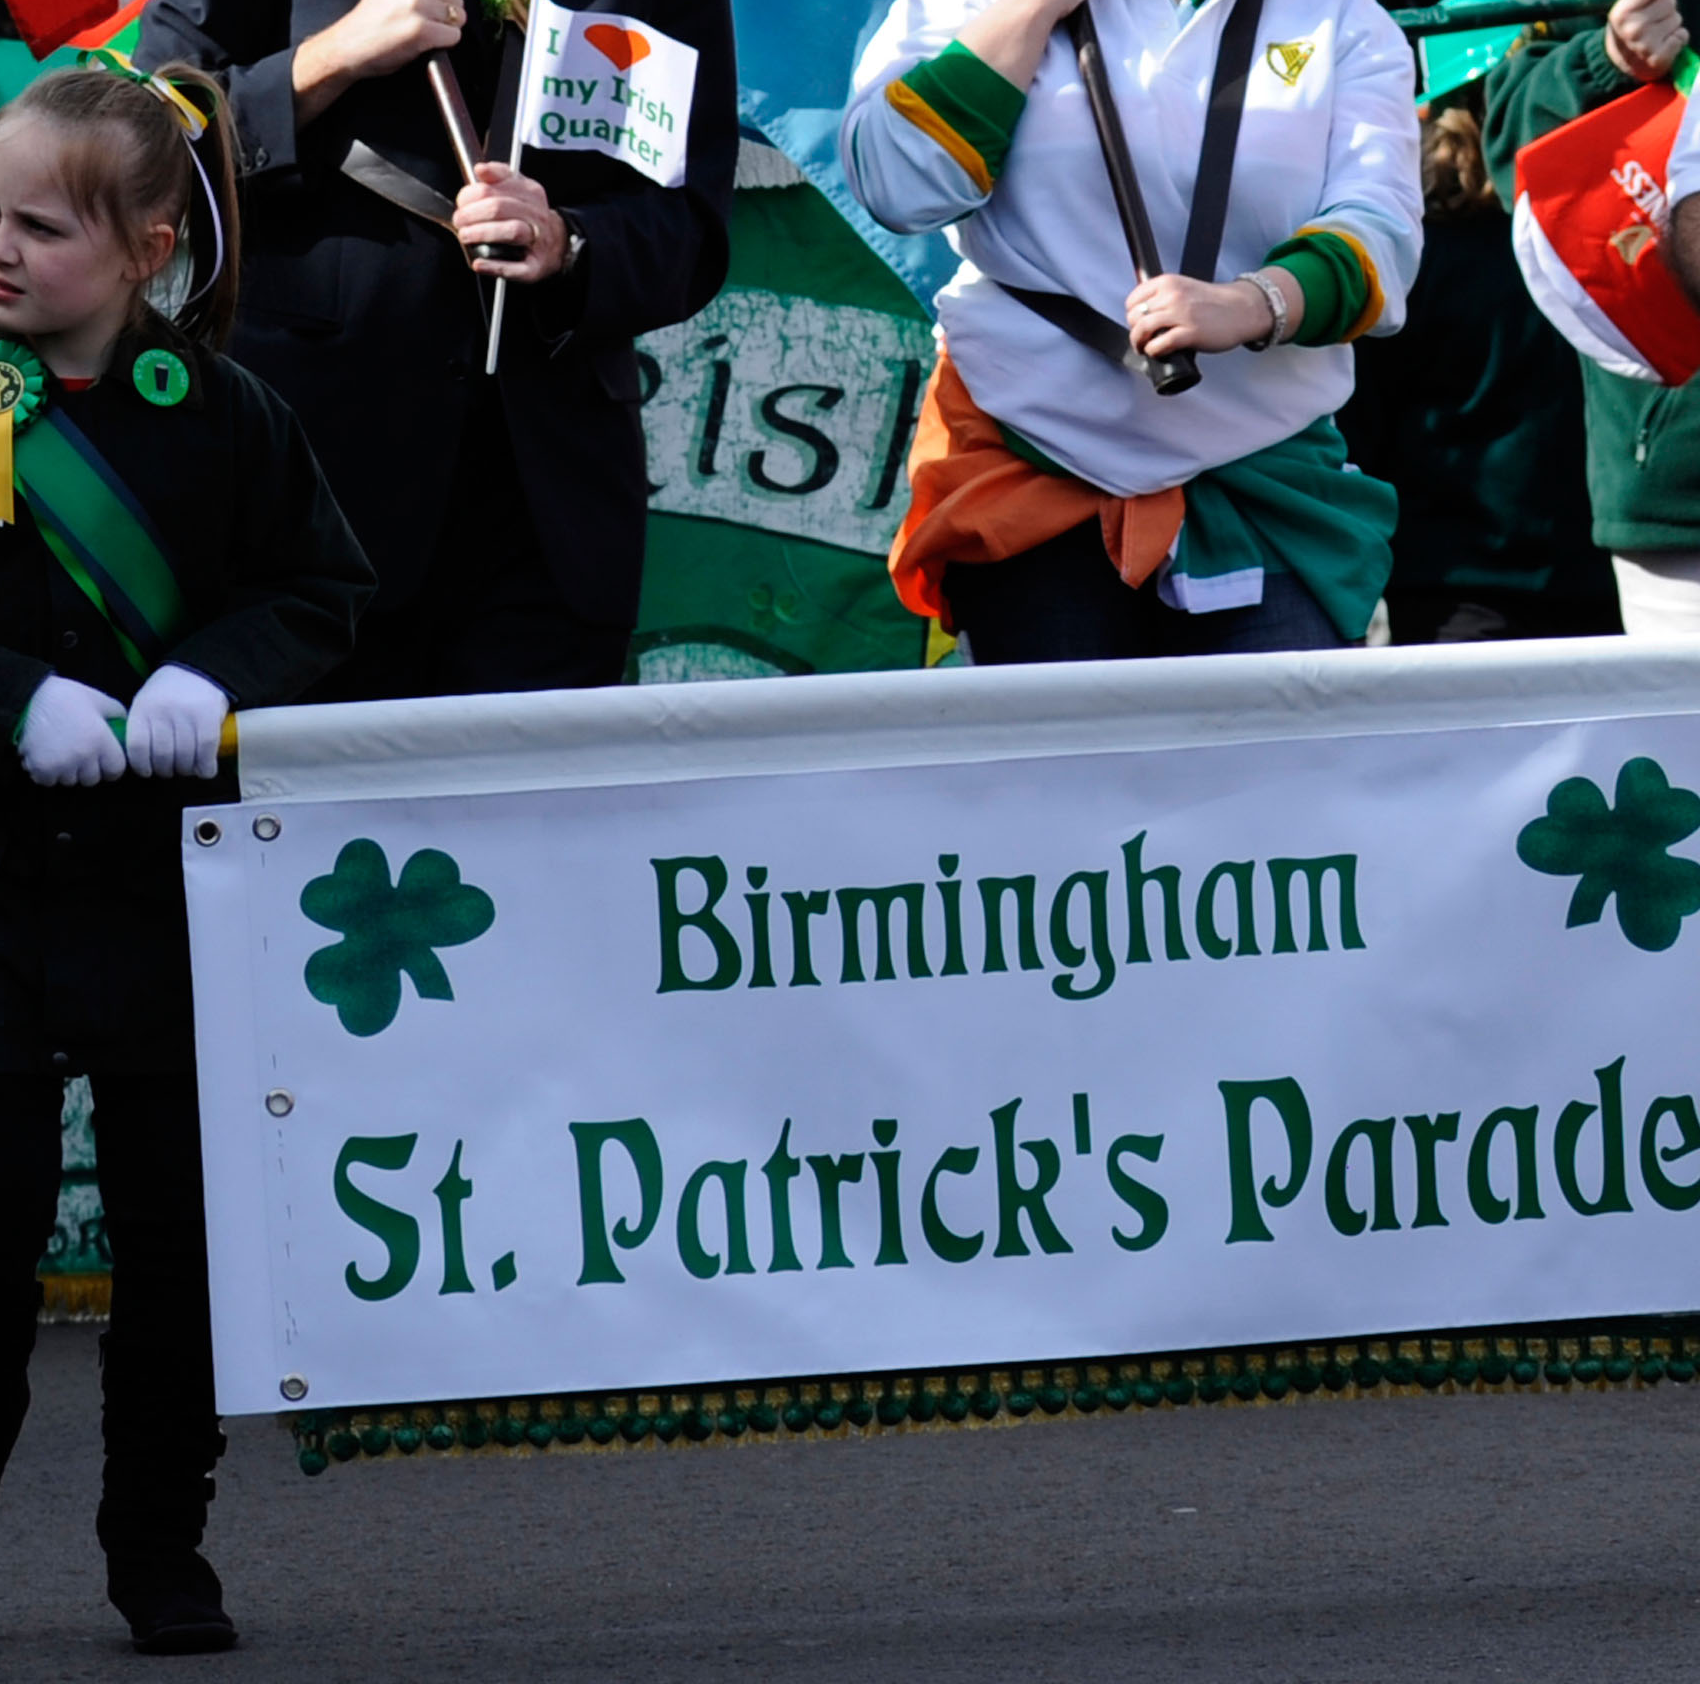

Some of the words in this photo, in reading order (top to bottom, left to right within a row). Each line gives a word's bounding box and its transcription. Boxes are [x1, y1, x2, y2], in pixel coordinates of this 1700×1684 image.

[546, 27, 560, 56] I
[542, 75, 599, 106] my
[610, 74, 674, 133] Irish
[540, 111, 663, 167] Quarter
[1610, 160, 1669, 228] NESS
[650, 829, 1367, 1001] Birmingham
[333, 1131, 518, 1302] St.
[568, 1092, 1170, 1287] Patrick's
